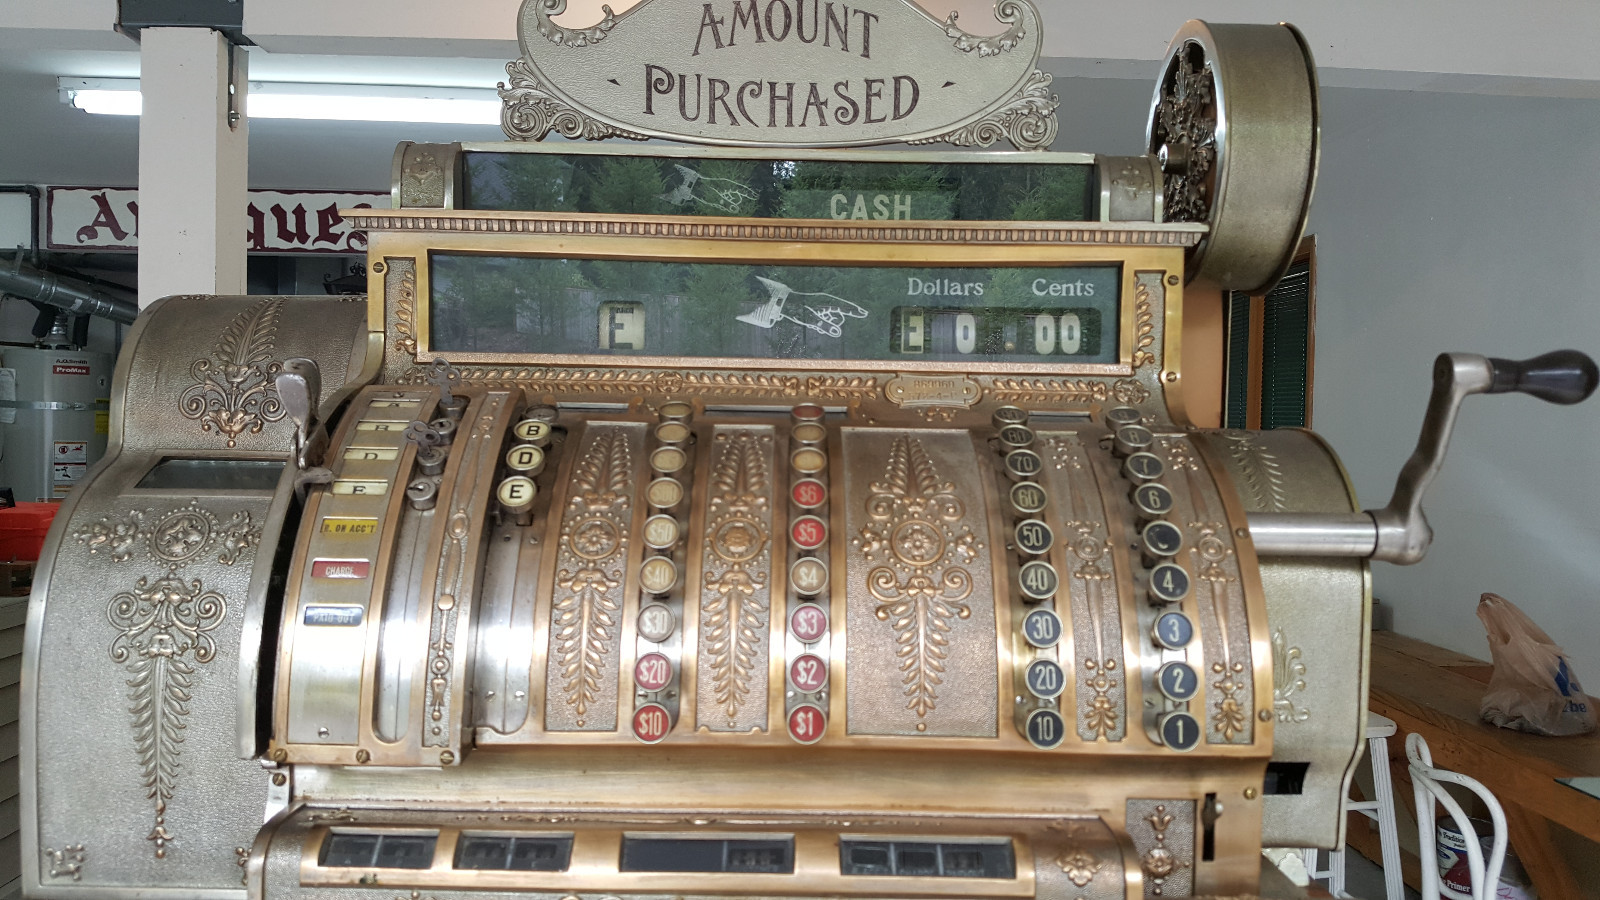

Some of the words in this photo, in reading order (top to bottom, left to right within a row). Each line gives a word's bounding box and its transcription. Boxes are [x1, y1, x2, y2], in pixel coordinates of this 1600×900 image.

[691, 0, 880, 59] AMOUNT
[642, 63, 920, 128] PURCHASED
[830, 193, 912, 220] CASH
[907, 277, 984, 296] Dollars
[1032, 278, 1095, 297] Cents
[526, 425, 541, 436] B
[1007, 430, 1026, 443] 80
[1128, 430, 1140, 444] 8
[518, 451, 533, 465] D
[1014, 456, 1034, 472] 70
[509, 484, 524, 499] E
[798, 485, 817, 504] $6
[1017, 489, 1038, 508] 60
[1148, 489, 1161, 509] 6
[335, 524, 346, 533] ON
[648, 522, 674, 543] $50
[798, 523, 817, 543] $5
[1022, 525, 1043, 547] 50
[325, 566, 354, 577] CHARGE
[644, 565, 670, 586] $40
[798, 565, 818, 587] $4
[1025, 568, 1048, 591] 40
[1162, 569, 1174, 593] 4
[642, 610, 668, 634] $30
[798, 610, 819, 635] $3
[1031, 615, 1054, 640] 30
[1168, 618, 1180, 643] 3
[640, 660, 666, 684] $20
[797, 659, 818, 685] $2
[1035, 665, 1057, 690] 20
[1172, 667, 1185, 694] 2
[638, 711, 663, 736] $10
[796, 711, 814, 737] $1
[1035, 716, 1054, 741] 10
[1176, 718, 1184, 744] 1
[1447, 879, 1471, 893] Primer
